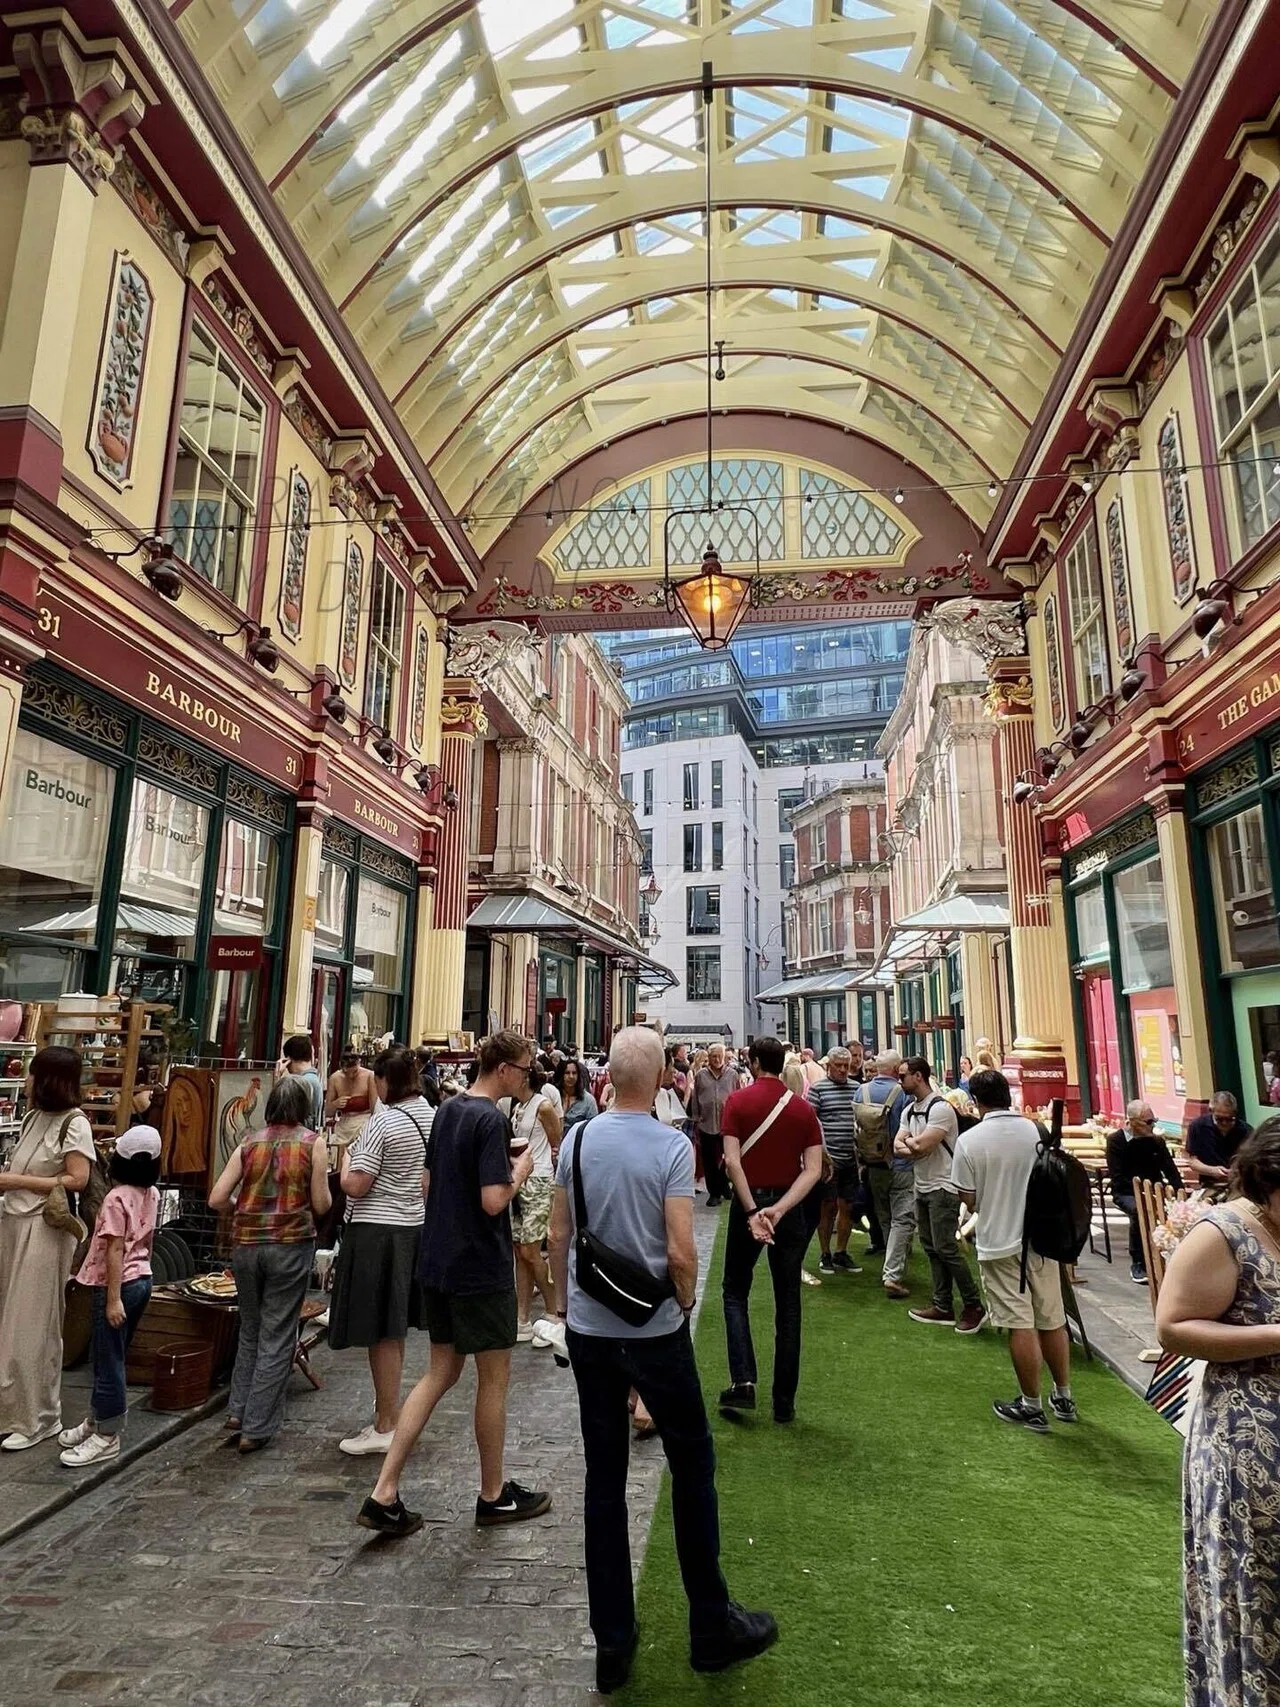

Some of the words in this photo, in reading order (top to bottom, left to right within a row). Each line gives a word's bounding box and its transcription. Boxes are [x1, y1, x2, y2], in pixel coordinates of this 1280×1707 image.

[38, 607, 60, 639] 31
[145, 671, 241, 744] BARBOUR
[1217, 695, 1249, 730] THE
[1180, 734, 1195, 757] 24
[285, 756, 297, 776] 31
[25, 768, 92, 809] Barbour
[354, 799, 399, 837] BARBOUR
[218, 947, 256, 957] Barbour
